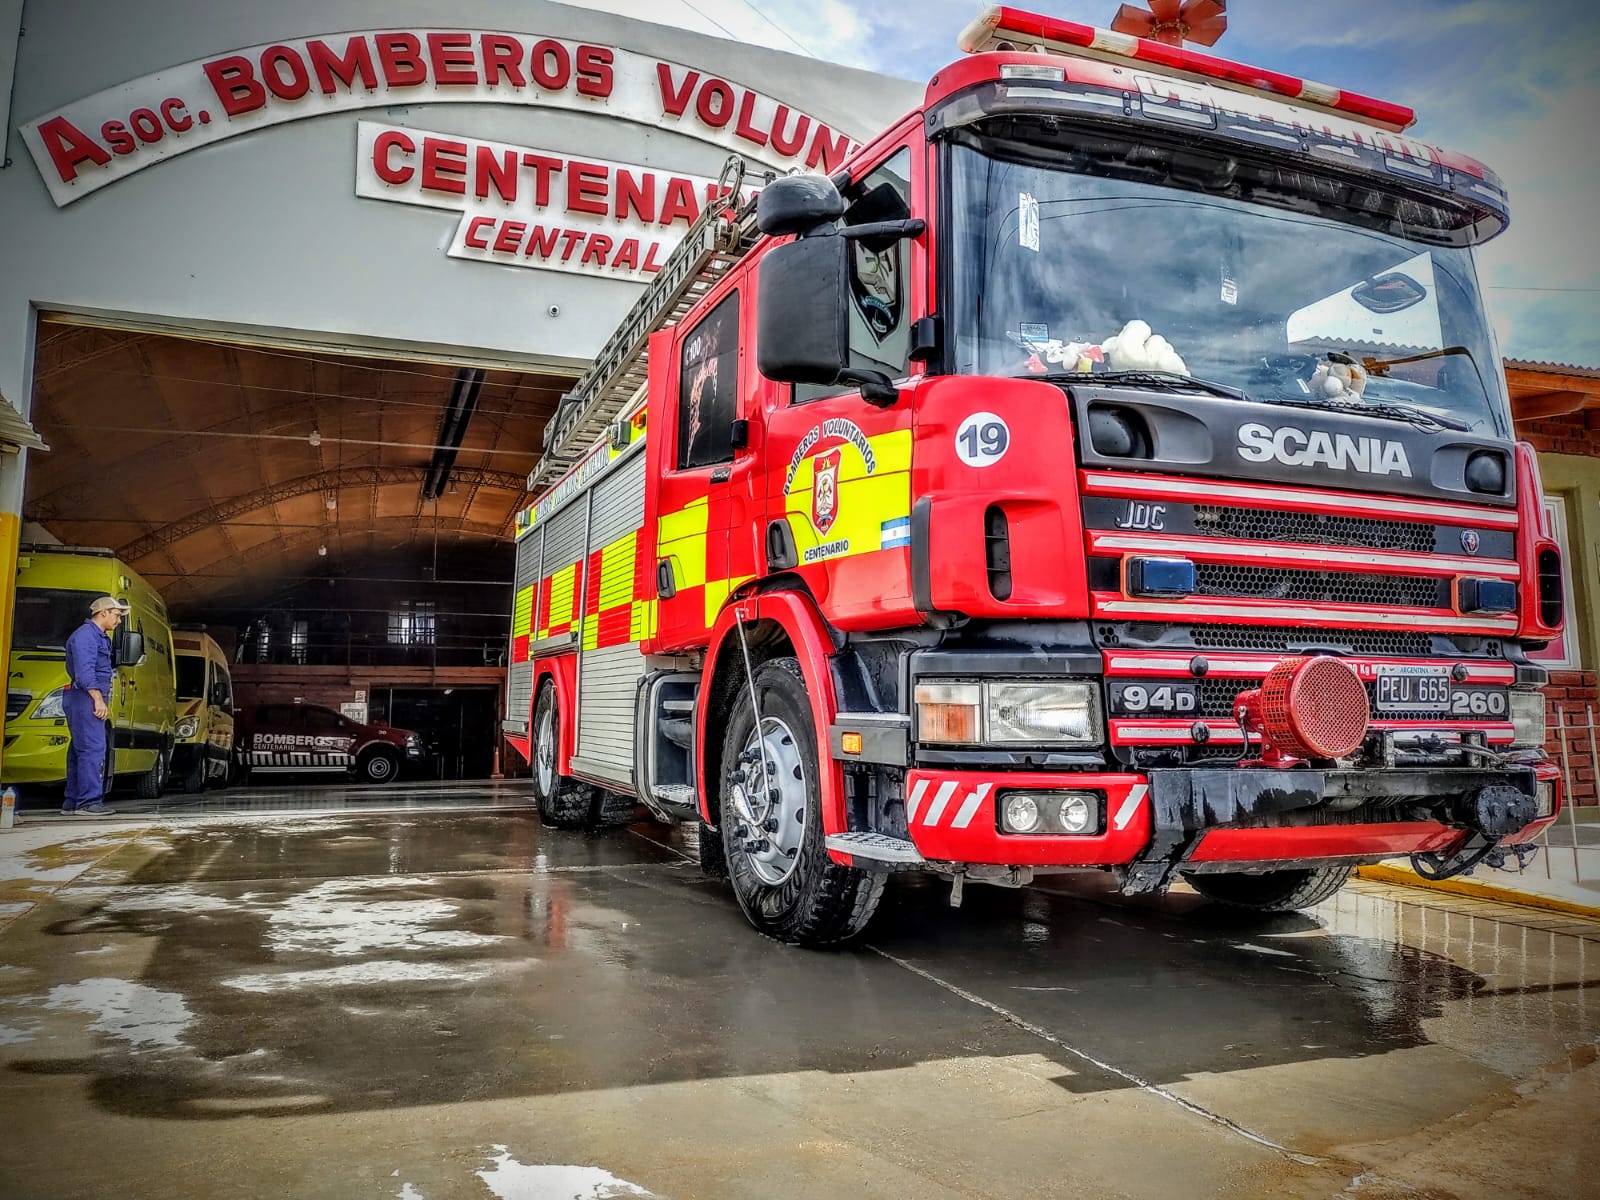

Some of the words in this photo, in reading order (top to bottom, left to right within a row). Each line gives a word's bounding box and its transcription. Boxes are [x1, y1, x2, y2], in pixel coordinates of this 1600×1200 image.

[202, 33, 614, 116] BOMBEROS
[656, 62, 864, 174] VOLUN
[465, 216, 663, 273] CENTRAL
[959, 422, 1008, 458] 19
[1237, 423, 1413, 478] SCANIA
[783, 425, 820, 496] BOMBEROS
[822, 418, 876, 474] VOLUNTARIOS
[804, 539, 849, 561] CENTENARIO
[1380, 677, 1410, 702] PEU
[1419, 677, 1448, 702] 665
[1451, 692, 1506, 715] 260
[253, 733, 334, 746] BOMBEROS
[253, 743, 295, 751] CENTENARIO
